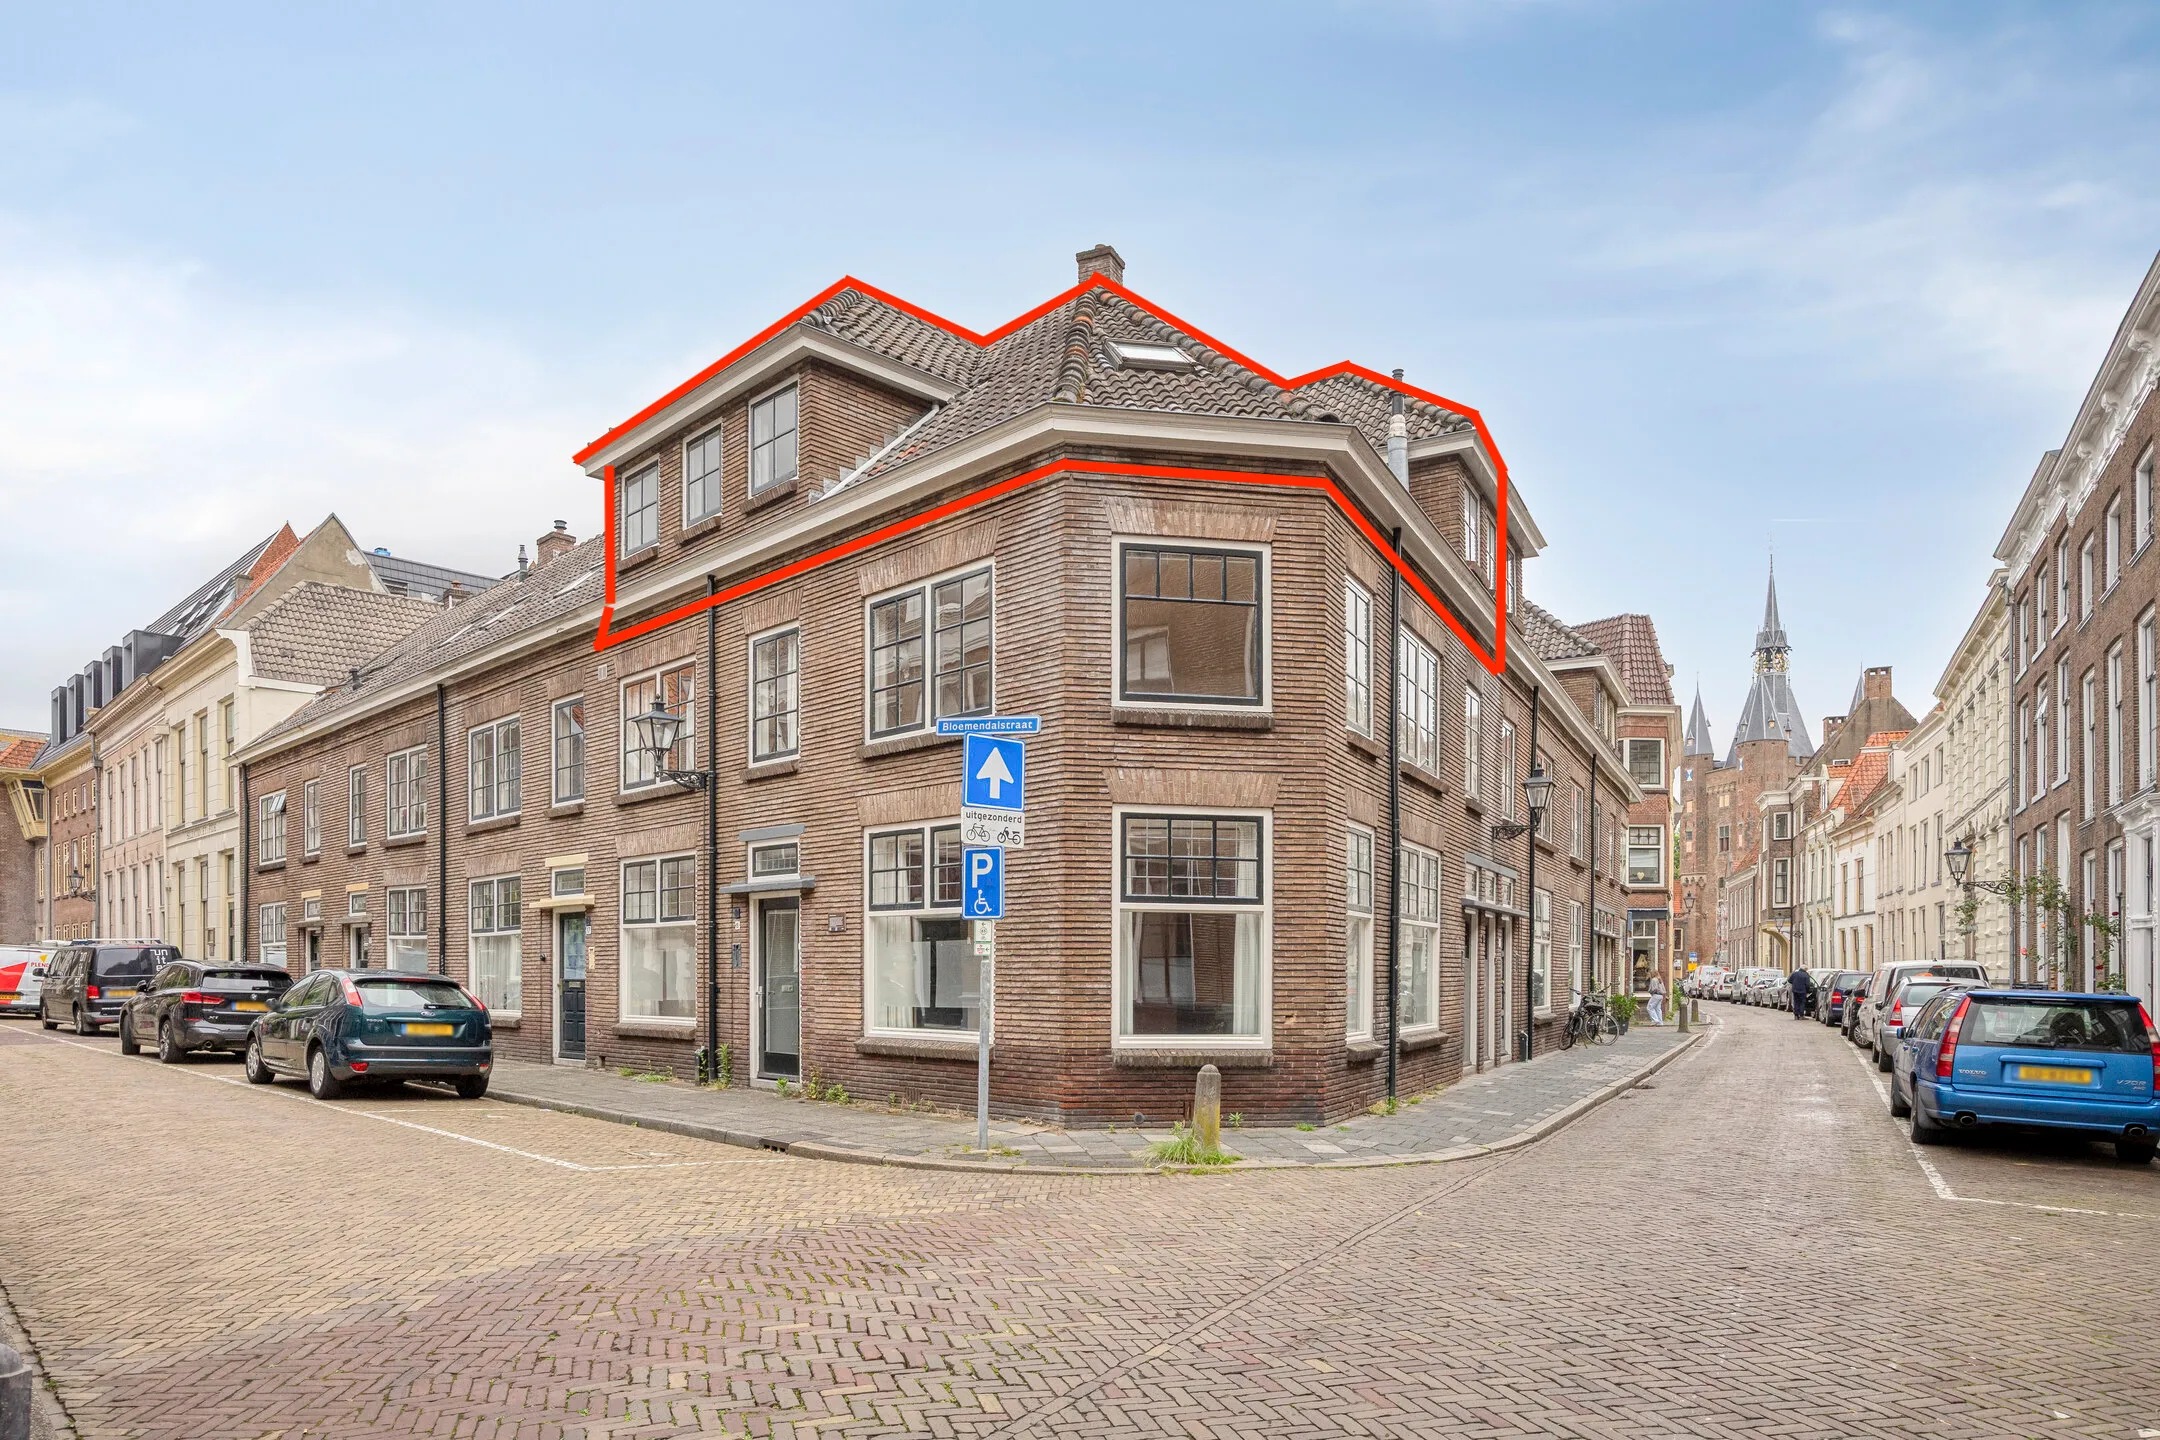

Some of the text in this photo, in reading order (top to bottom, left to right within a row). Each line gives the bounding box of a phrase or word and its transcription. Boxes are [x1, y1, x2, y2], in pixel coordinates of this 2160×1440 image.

[942, 721, 1033, 731] Bloemendalstraat
[965, 811, 1022, 824] uitgezonderd
[972, 852, 993, 888] P
